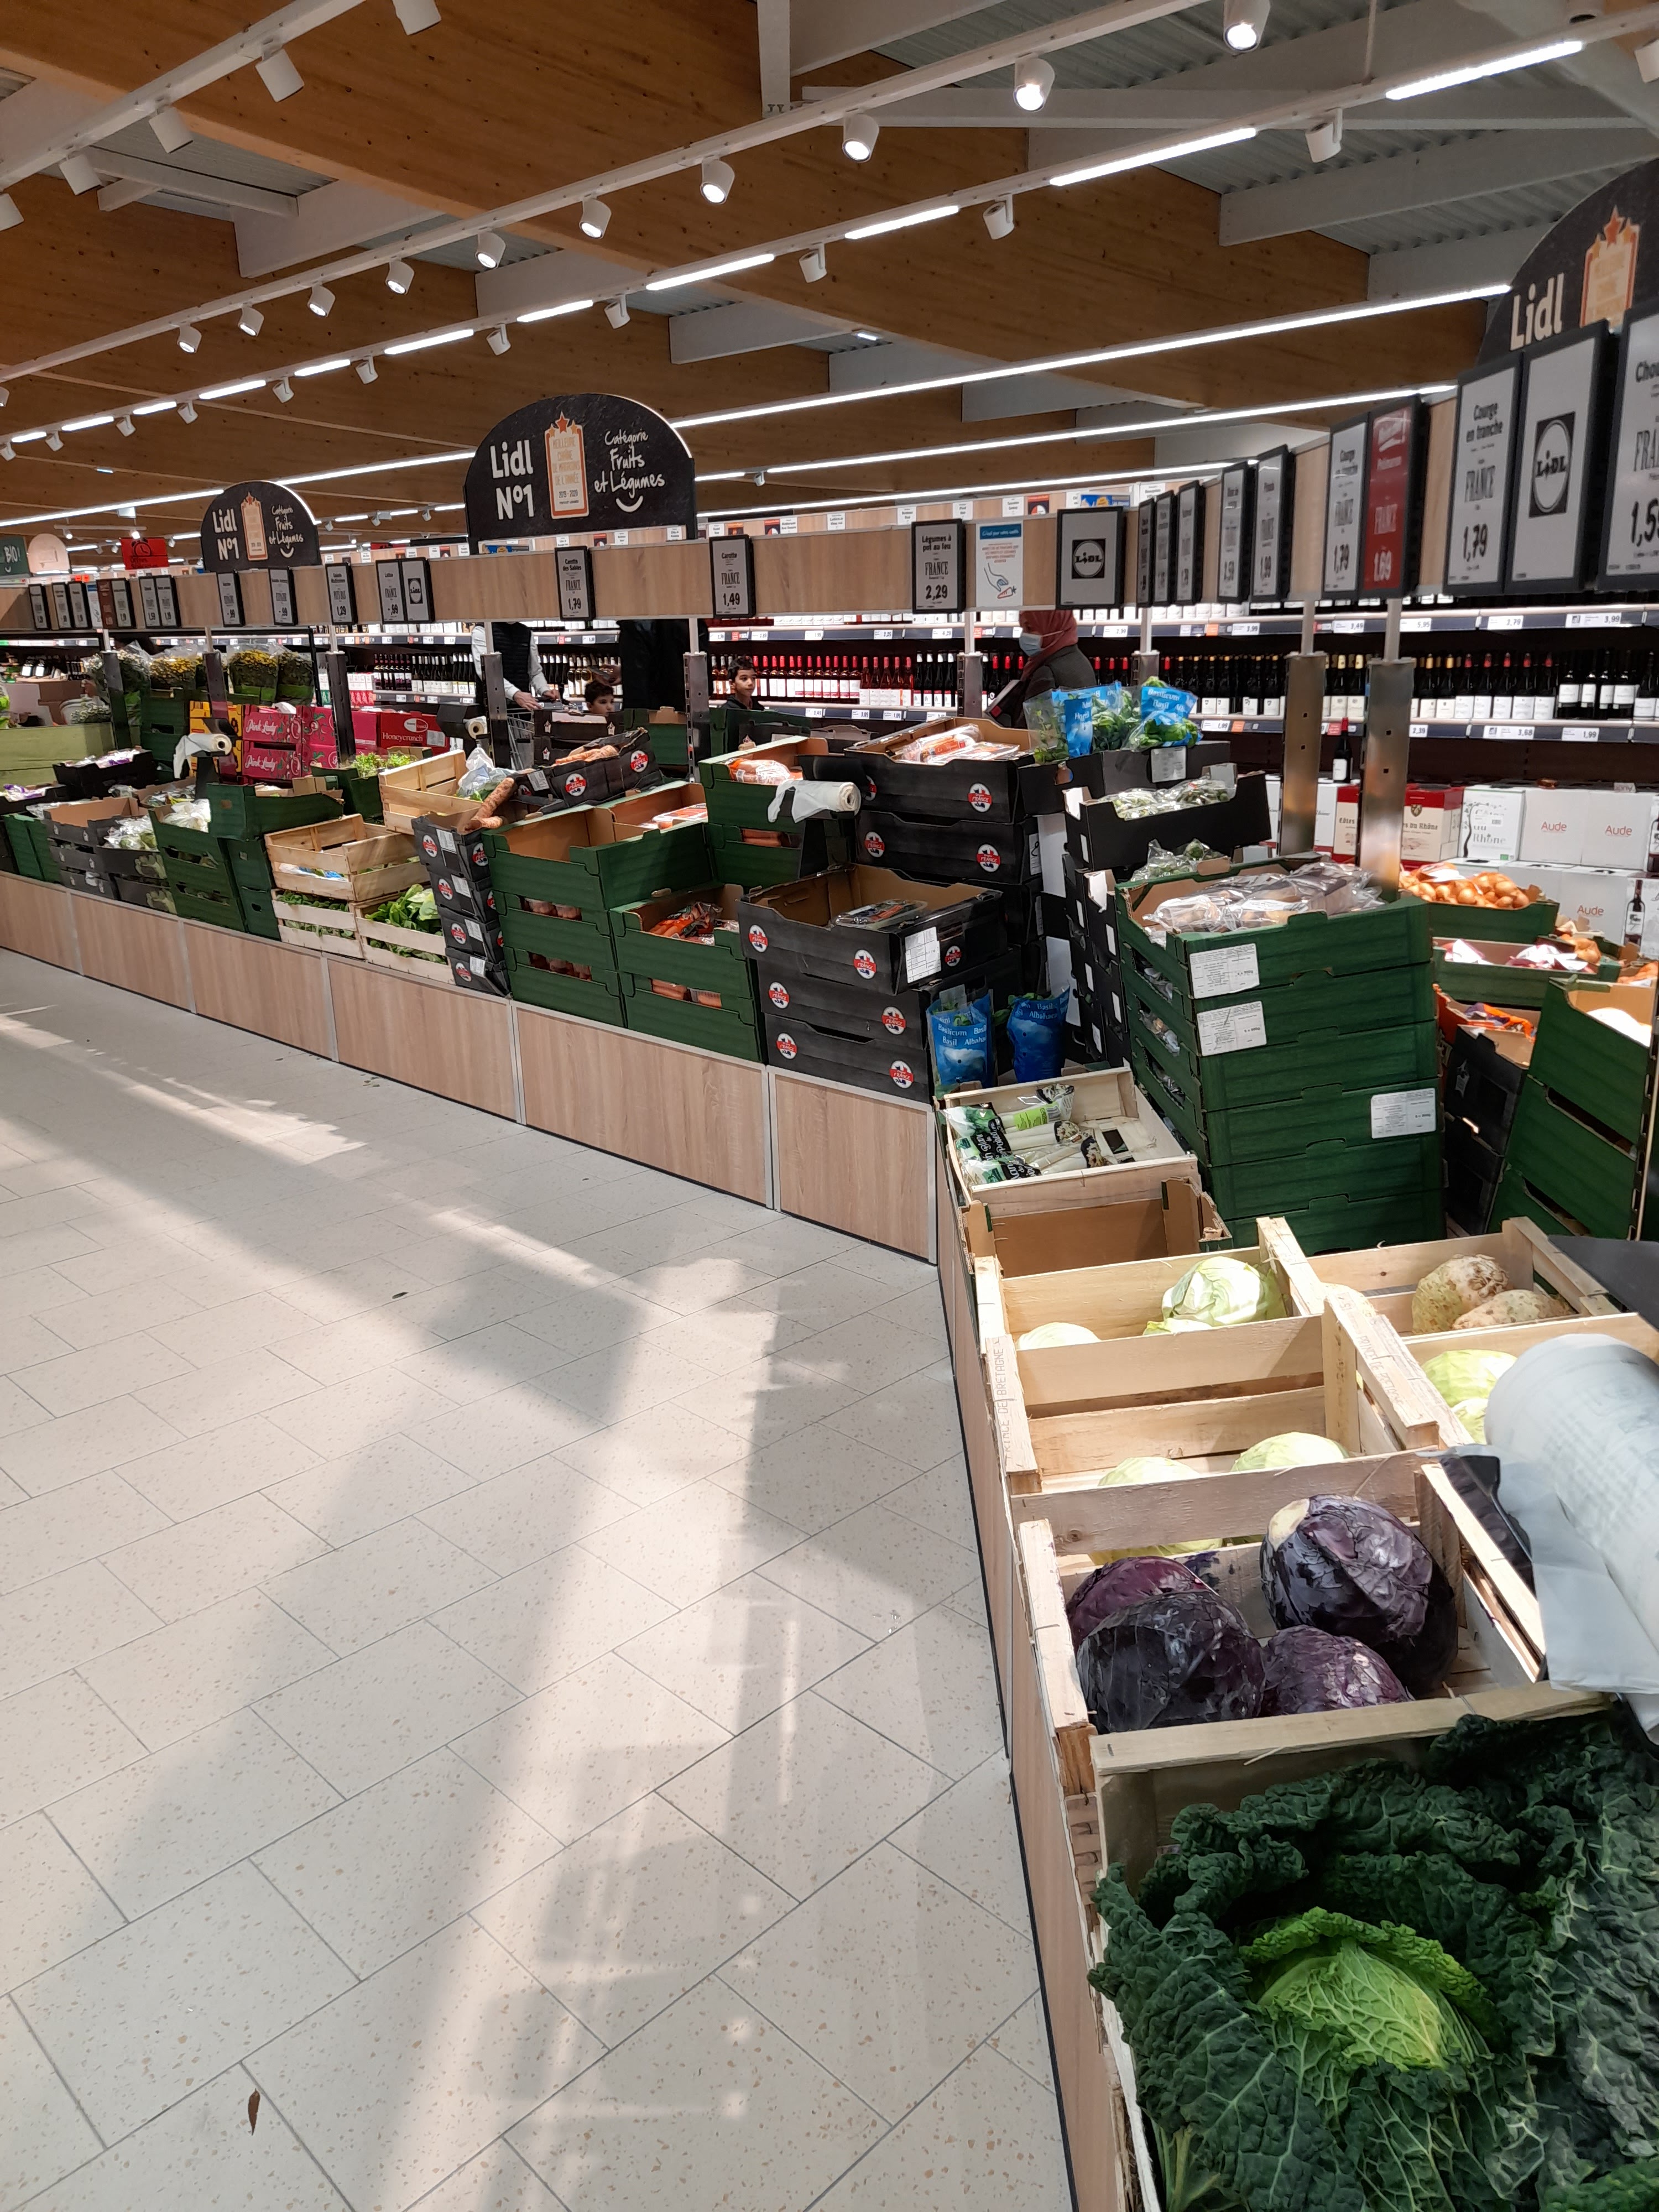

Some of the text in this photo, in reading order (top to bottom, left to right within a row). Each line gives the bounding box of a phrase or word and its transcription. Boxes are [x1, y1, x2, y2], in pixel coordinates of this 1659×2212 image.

[1510, 273, 1564, 351] Lidl
[604, 429, 649, 448] Catégorie
[490, 440, 534, 479] Lidl
[609, 447, 645, 471] Fruits
[1535, 450, 1567, 479] LIDL
[594, 471, 665, 498] et Légumes
[212, 508, 238, 533] Lidl
[275, 516, 294, 531] Fruits
[922, 534, 952, 544] Légumes à
[1463, 524, 1488, 562] 1,79
[4, 545, 21, 563] BIO!
[922, 544, 933, 552] pot
[1074, 552, 1102, 565] LIDL
[925, 561, 948, 576] FRANCE
[721, 572, 740, 585] FRANCE
[565, 580, 581, 591] FRANCE
[723, 592, 740, 607] 1,49
[926, 585, 948, 601] 2,29
[337, 606, 347, 616] 1,29
[568, 598, 581, 611] 1,79
[246, 719, 278, 736] Pink Lady
[382, 732, 424, 742] Honeycrunch
[245, 755, 278, 772] Pink Lady
[1418, 822, 1438, 831] Rhône
[1541, 821, 1567, 832] Aude
[1605, 825, 1632, 836] Aude
[1577, 905, 1604, 916] Aude
[857, 961, 874, 971] FRANCE
[885, 1018, 904, 1027] FRANCE
[938, 1023, 967, 1036] Basilicum
[779, 1043, 796, 1052] FRANCE
[942, 1036, 957, 1046] Basil
[893, 1071, 913, 1081] FRANCE
[993, 1347, 1007, 1396] BRETAGNE
[997, 1397, 1009, 1415] DE
